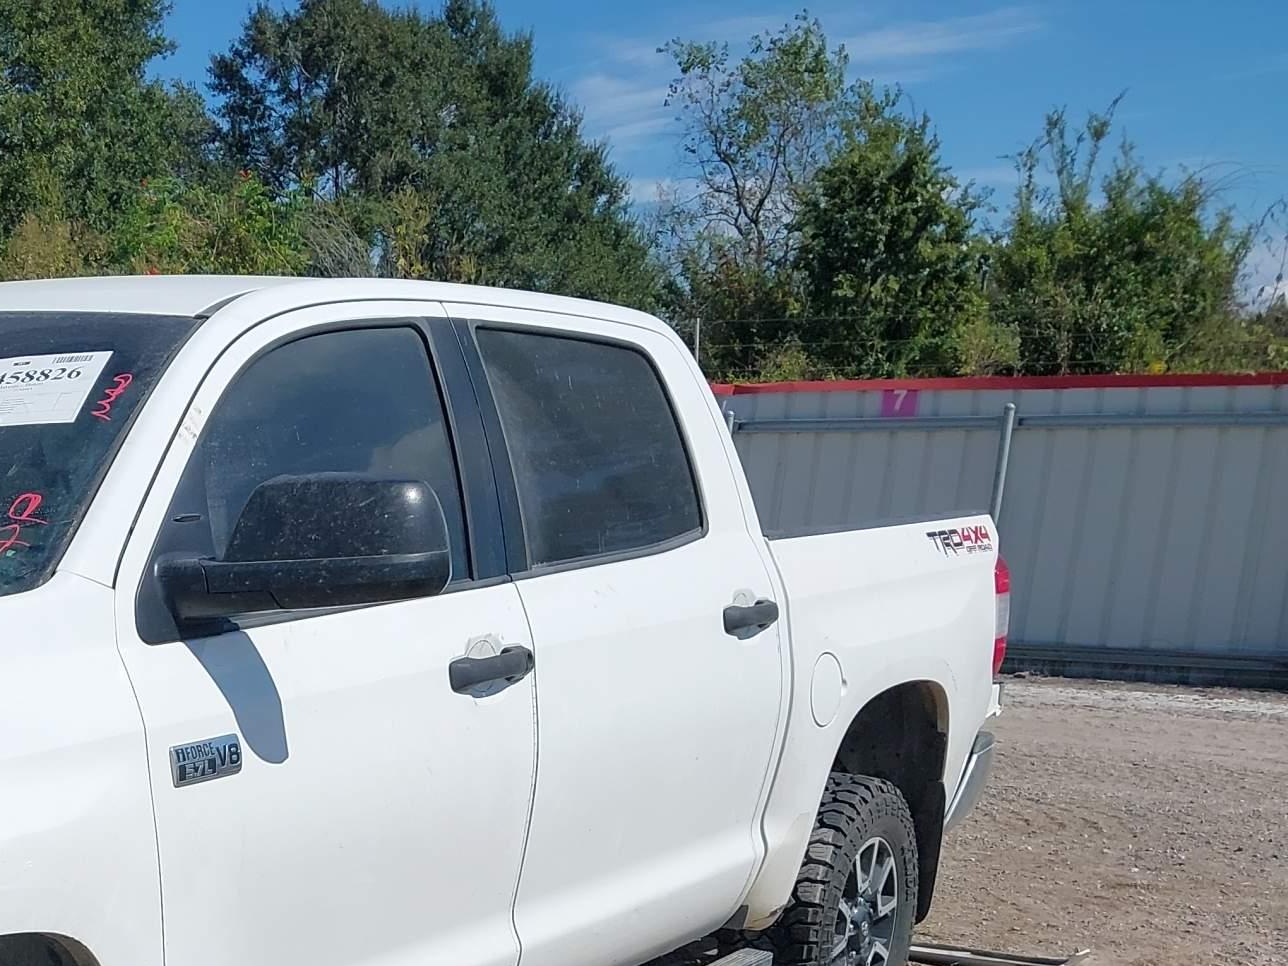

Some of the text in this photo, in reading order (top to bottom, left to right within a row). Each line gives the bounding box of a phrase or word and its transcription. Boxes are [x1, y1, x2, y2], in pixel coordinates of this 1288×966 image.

[893, 389, 908, 412] 7
[926, 528, 963, 557] TRD
[215, 743, 241, 767] V8
